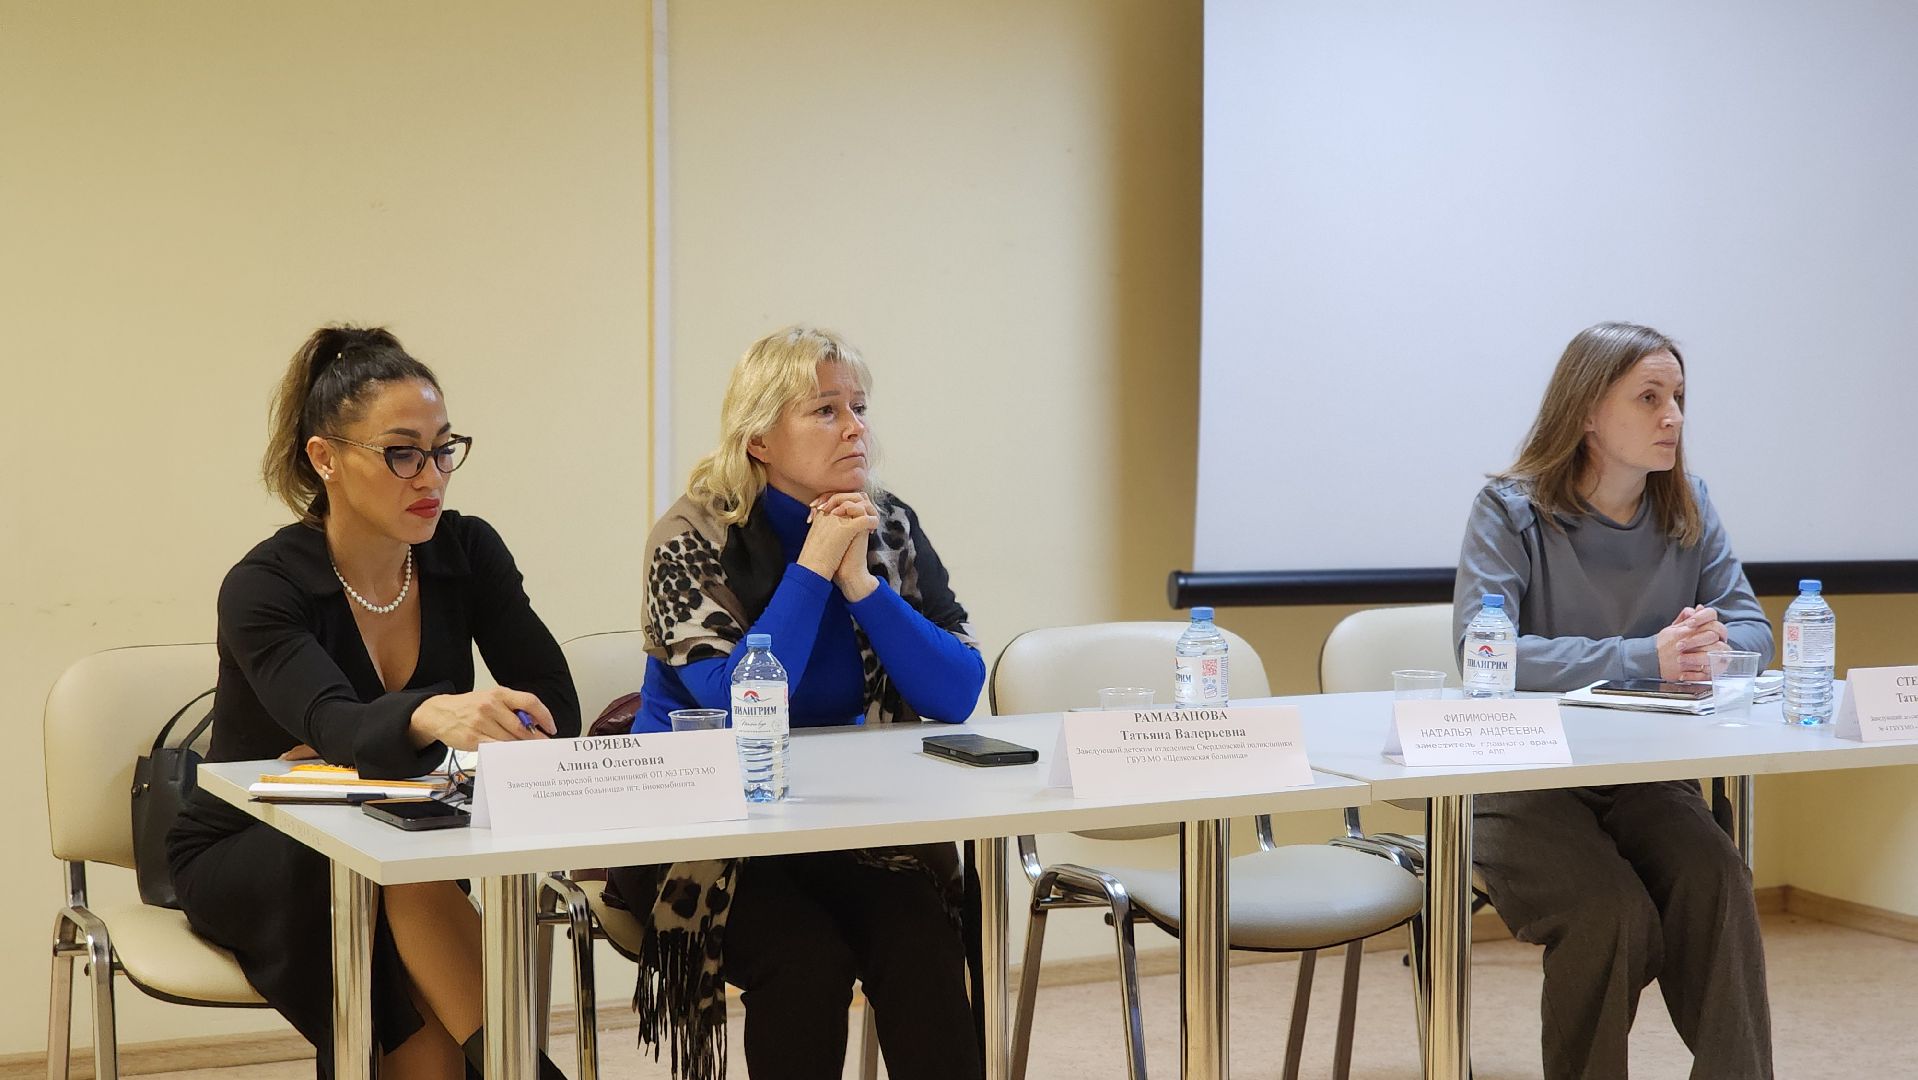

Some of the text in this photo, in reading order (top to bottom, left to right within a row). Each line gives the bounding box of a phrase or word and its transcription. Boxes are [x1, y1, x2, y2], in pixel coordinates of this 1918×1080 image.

[1896, 676, 1918, 687] СТЕ
[1134, 709, 1228, 723] РАМАЗАНОВА
[1443, 712, 1518, 723] ФИЛИМОНОВА
[1119, 727, 1247, 741] Татьяна Валерьевна
[1420, 726, 1546, 738] НАТАЛЬЯ АНДРЕЕВНА
[573, 736, 642, 752] ГОРЯЕВА
[1415, 739, 1558, 749] заместитель главного врача
[556, 755, 665, 773] Алина Олеговна
[1147, 754, 1162, 764] МО
[507, 776, 556, 789] Заведующий
[558, 774, 593, 788] взрослой
[701, 765, 716, 776] МО
